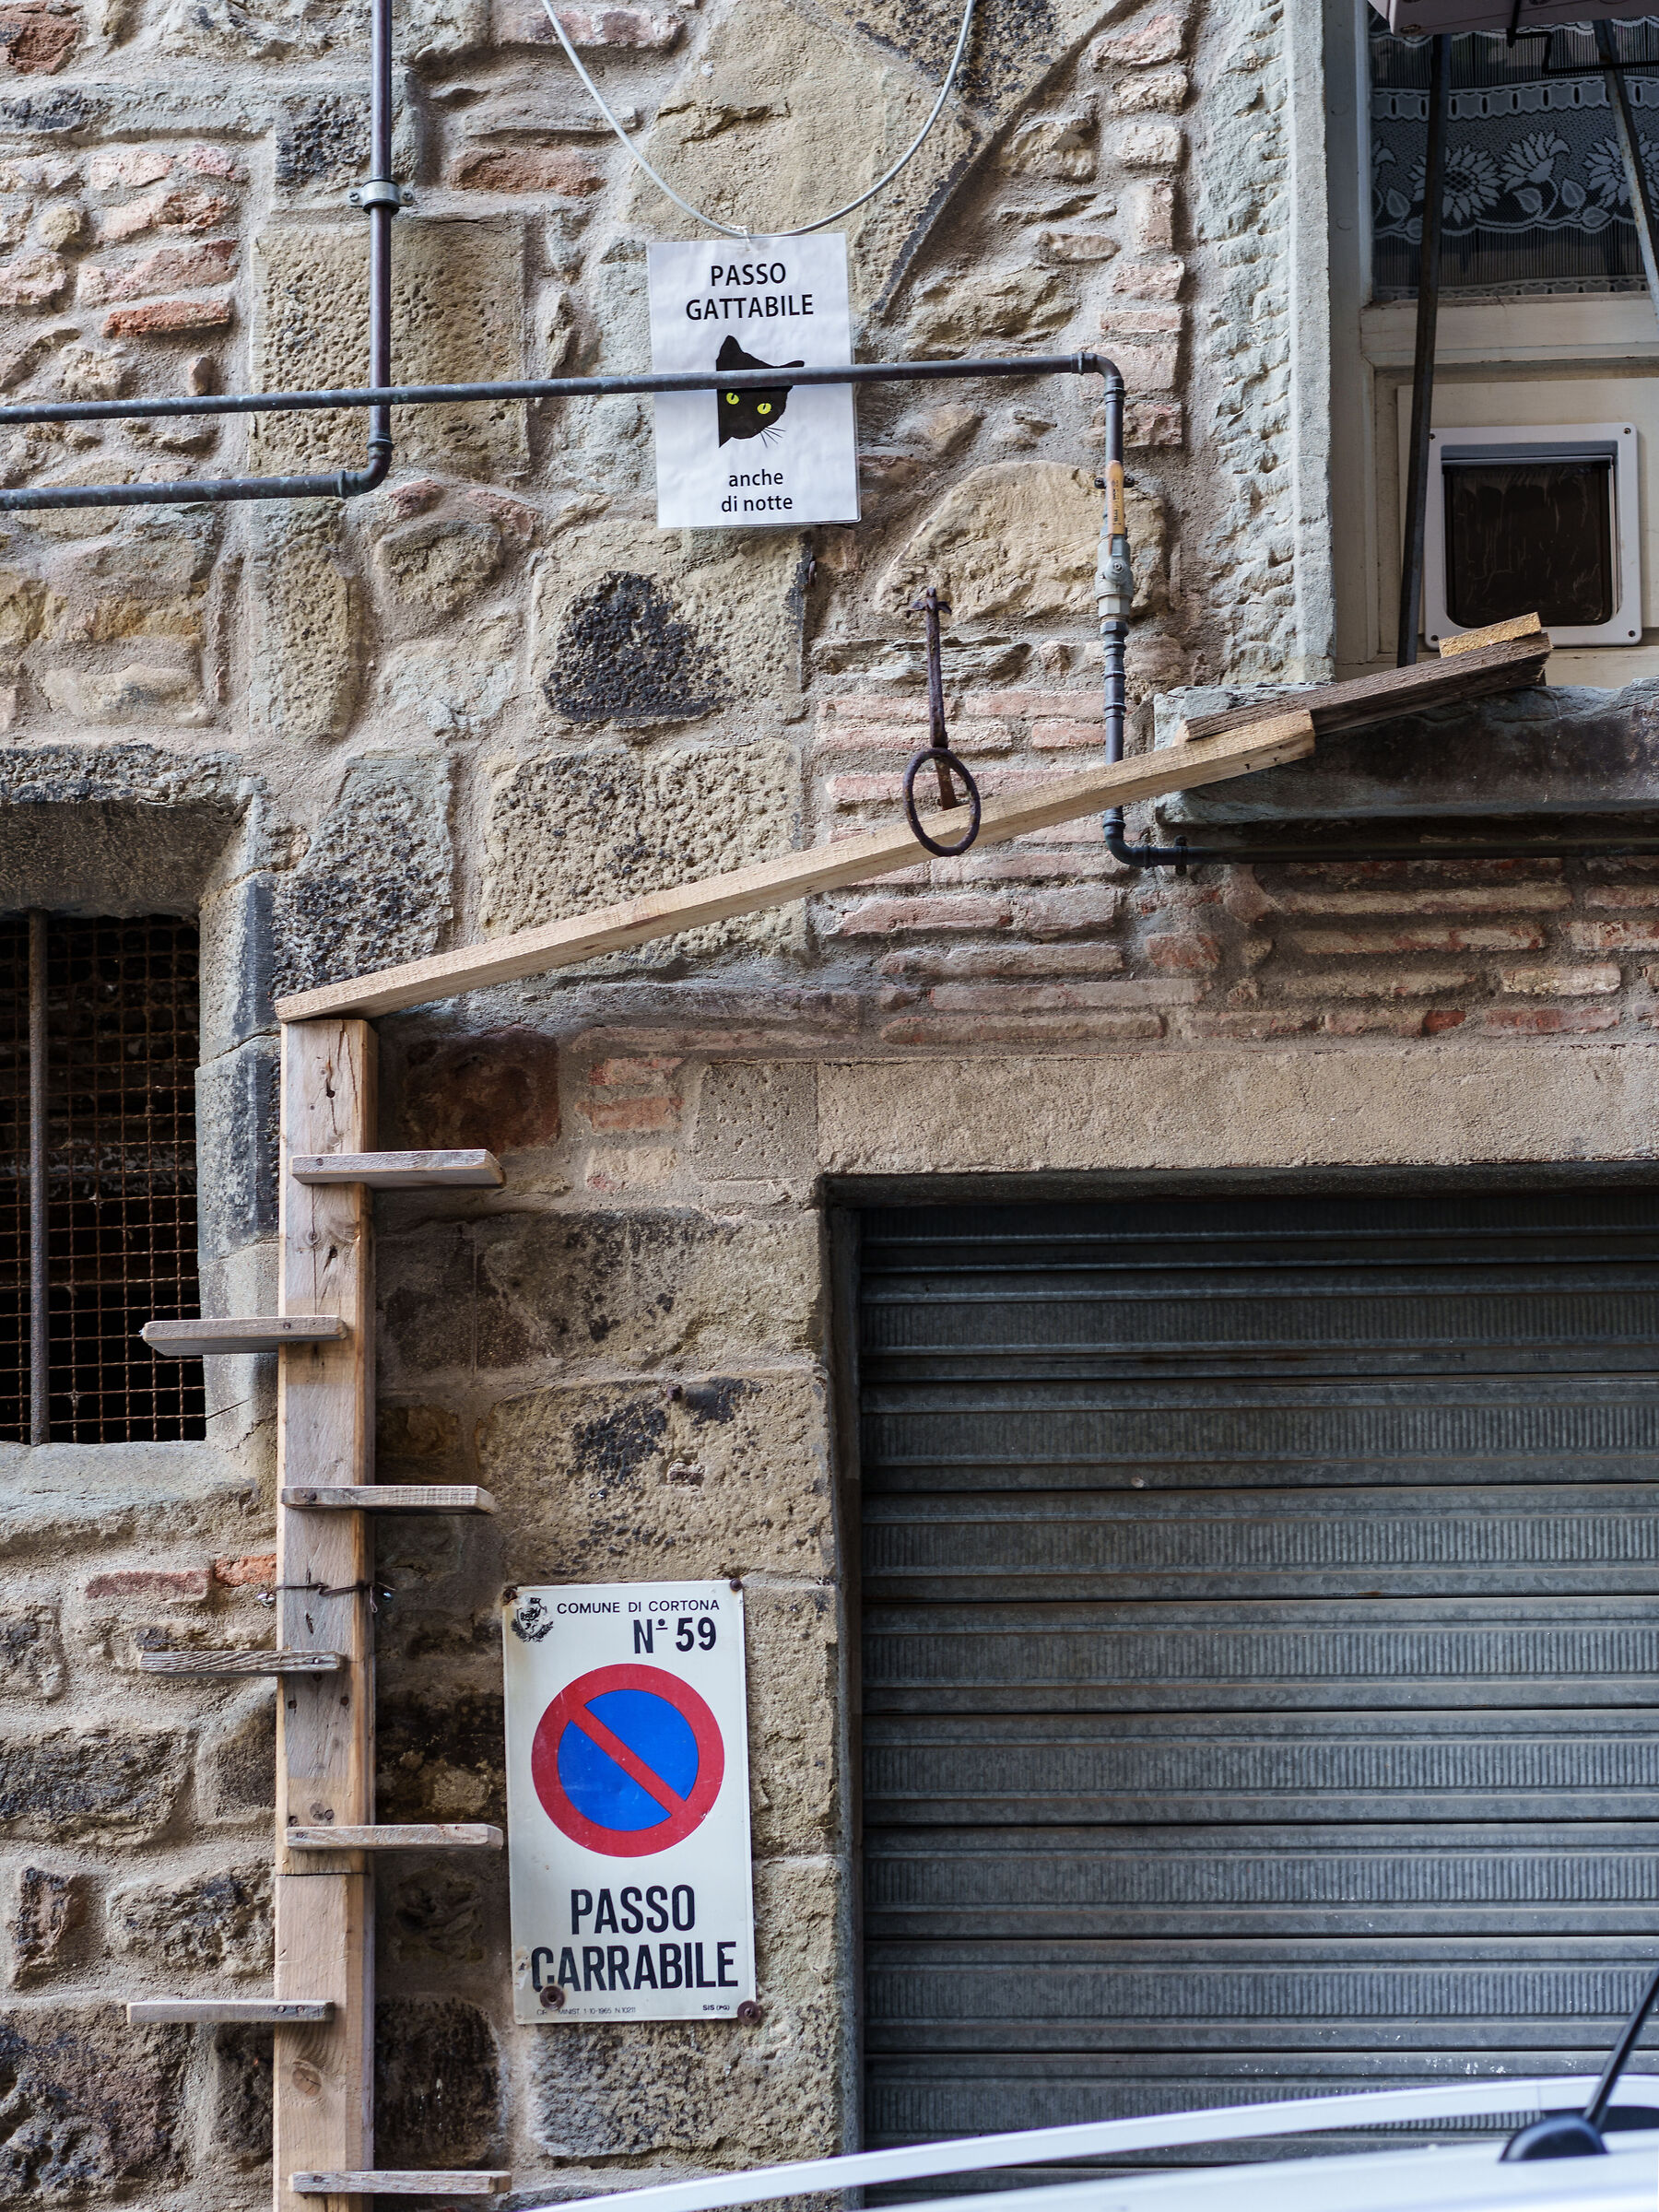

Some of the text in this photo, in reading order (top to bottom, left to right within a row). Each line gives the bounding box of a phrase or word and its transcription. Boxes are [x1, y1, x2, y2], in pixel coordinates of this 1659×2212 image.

[711, 262, 786, 287] PASSO
[686, 293, 814, 321] GATTABILE
[728, 468, 783, 488] anche
[721, 495, 793, 512] di notte
[557, 1599, 720, 1614] COMUNE DI CORTONA
[675, 1616, 717, 1653] 59
[571, 1884, 696, 1936] PASSO
[531, 1941, 738, 1993] CARRABILE
